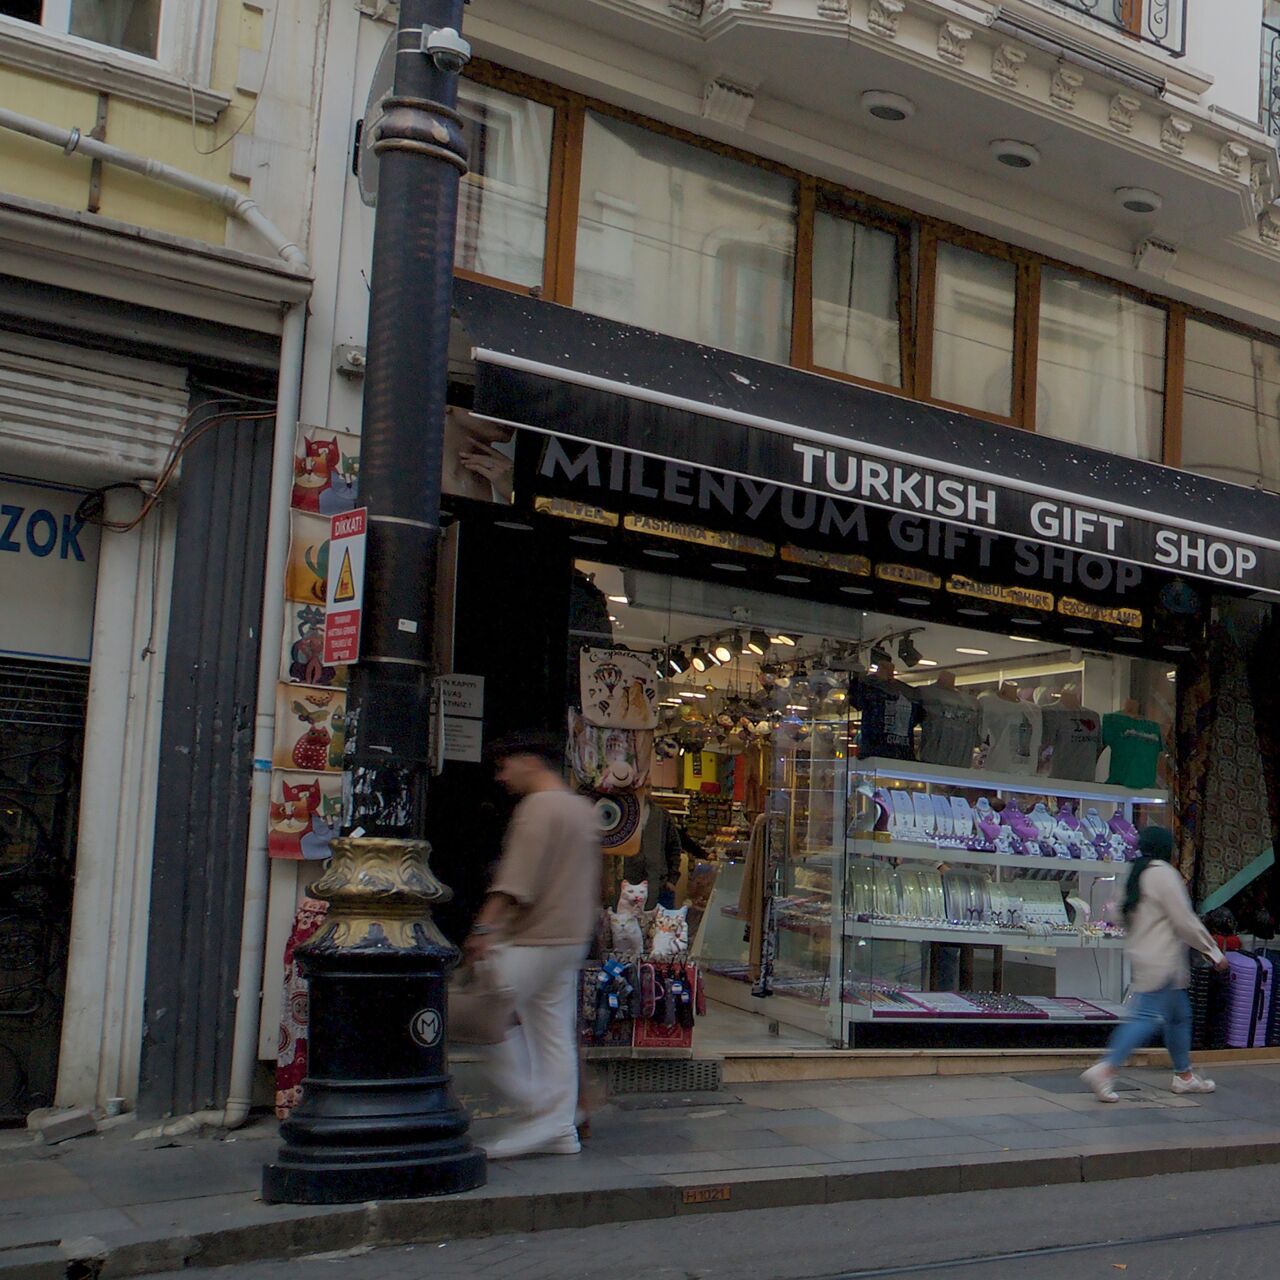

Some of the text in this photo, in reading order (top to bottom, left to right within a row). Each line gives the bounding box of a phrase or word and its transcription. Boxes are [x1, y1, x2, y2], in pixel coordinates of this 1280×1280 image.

[793, 442, 1258, 580] TURKISH GIFT SHOP
[889, 513, 1000, 569] GIFT
[1014, 538, 1143, 594] SHOP
